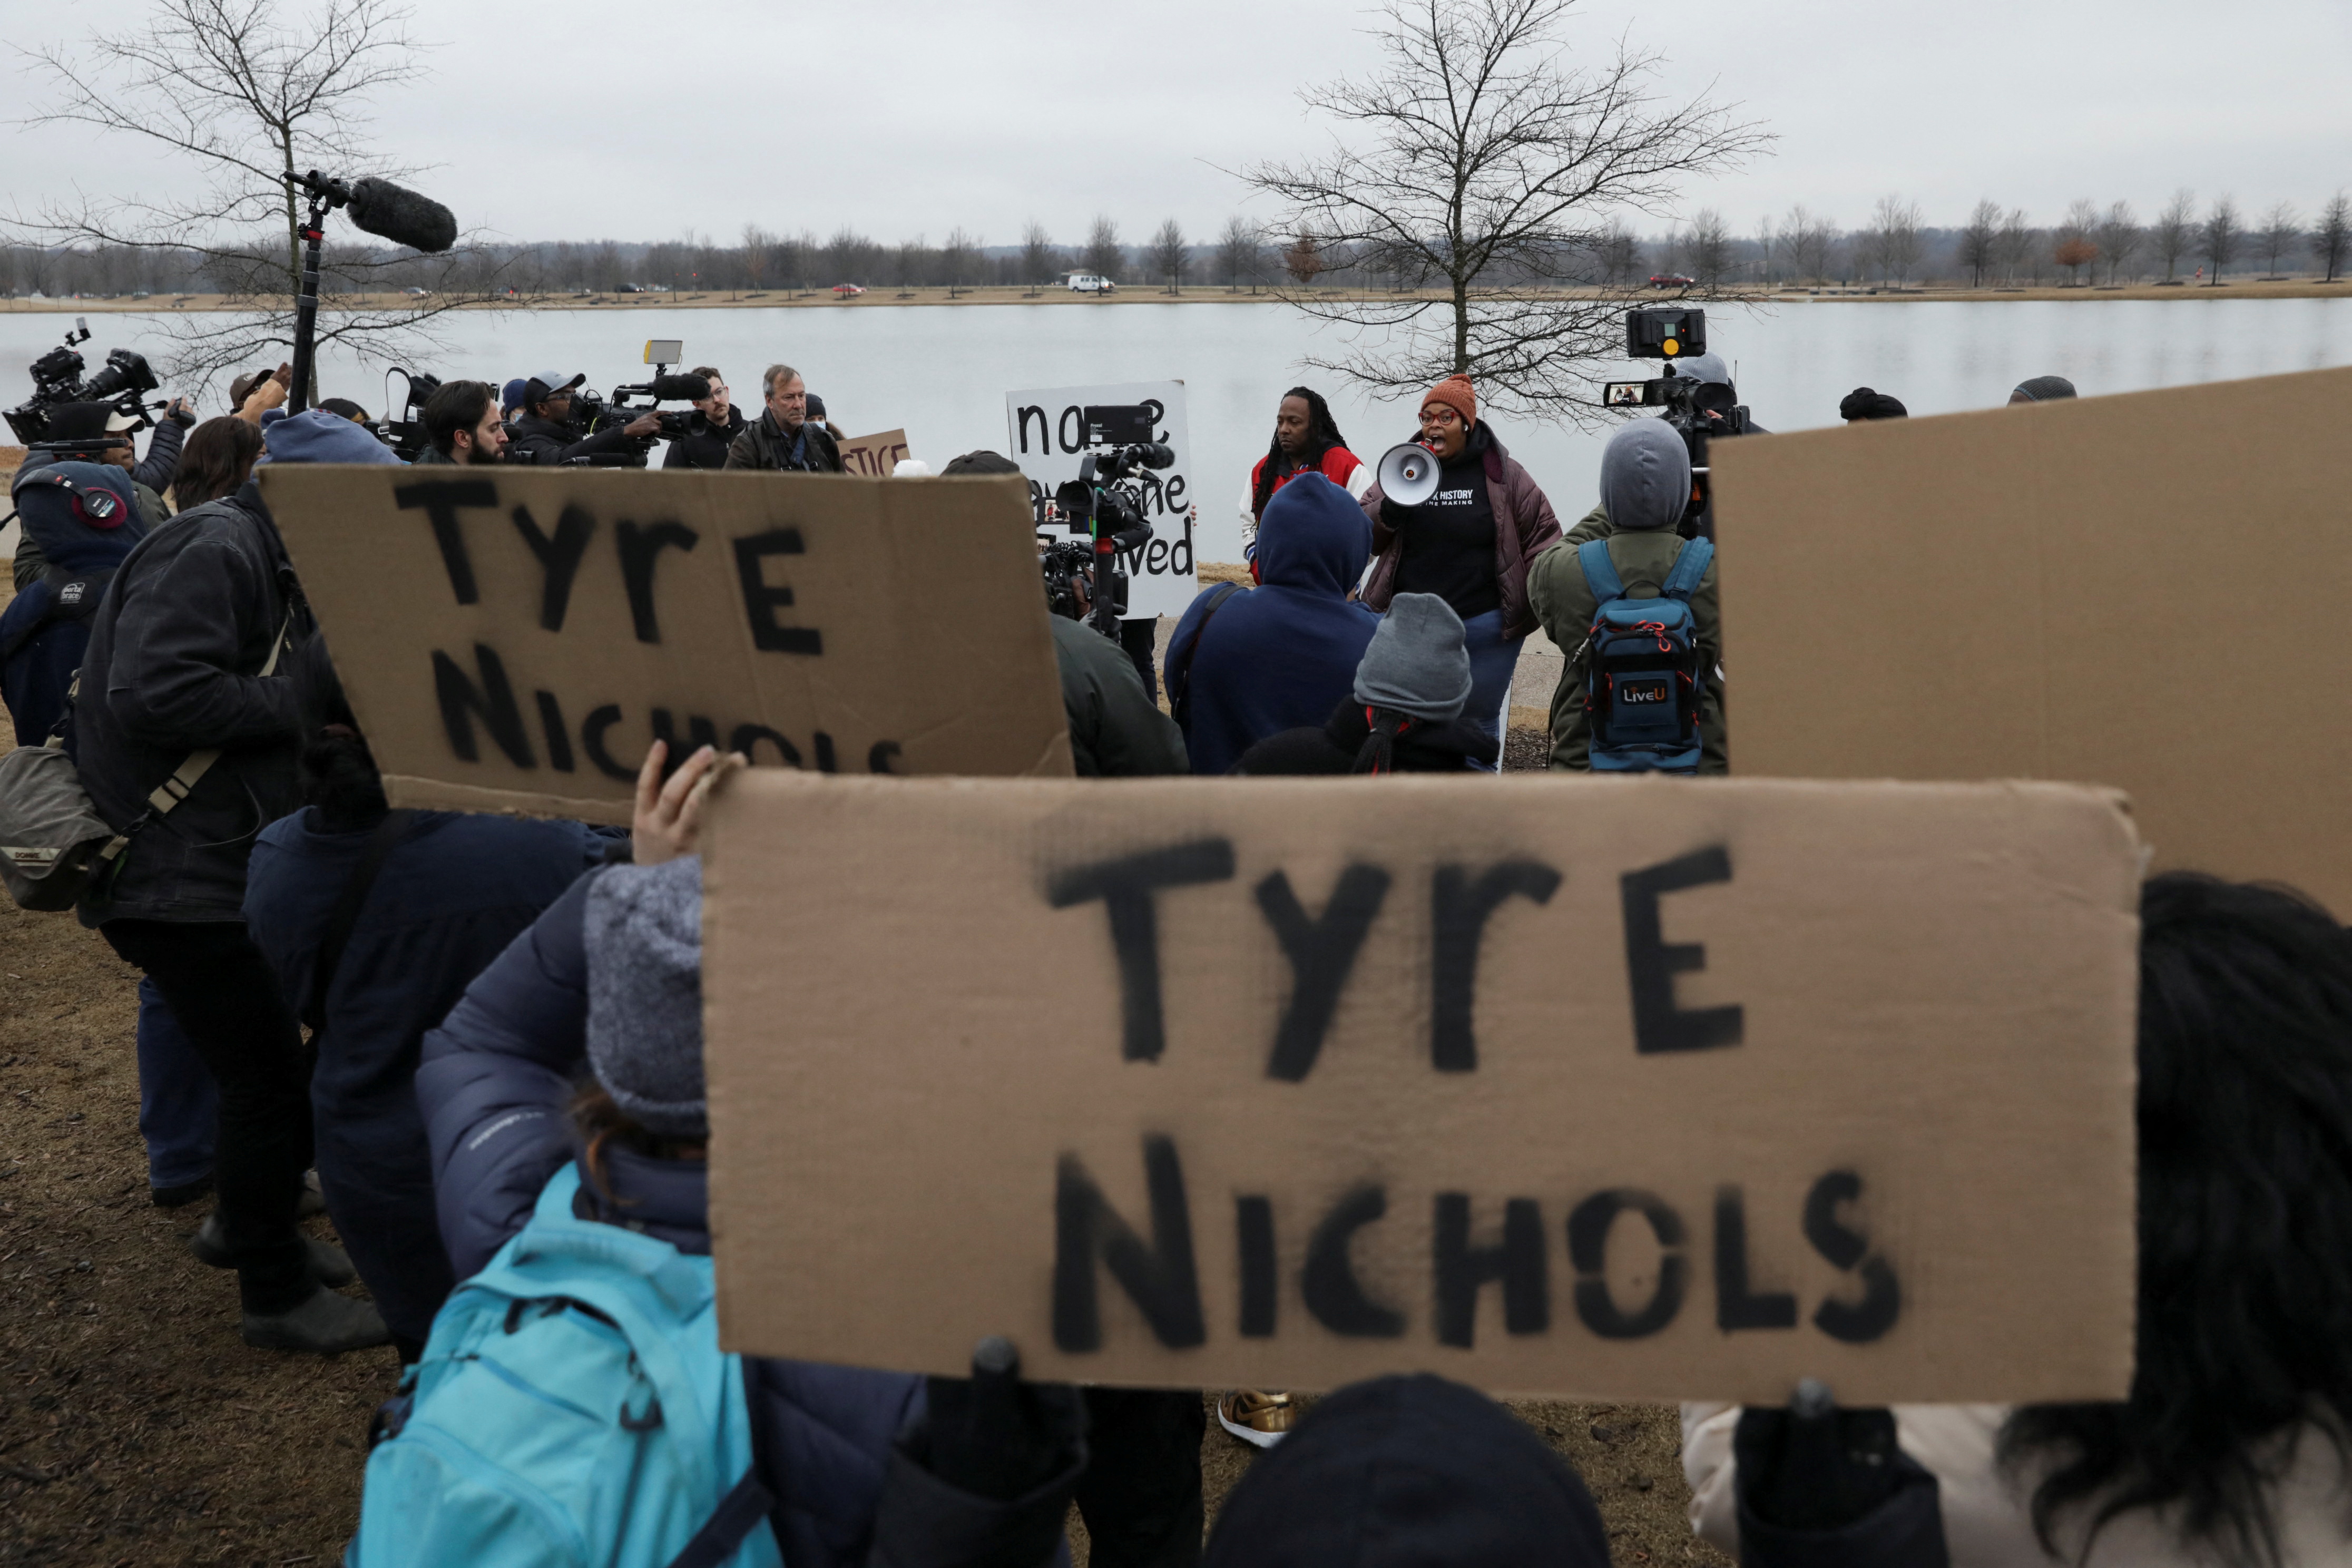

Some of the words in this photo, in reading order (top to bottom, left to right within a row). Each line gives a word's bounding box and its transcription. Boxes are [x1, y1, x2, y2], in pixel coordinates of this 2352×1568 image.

[1440, 489, 1473, 499] HISTORY
[93, 497, 102, 507] SONY
[1623, 687, 1665, 702] LiveU
[1047, 1133, 1905, 1354] NICHOLS
